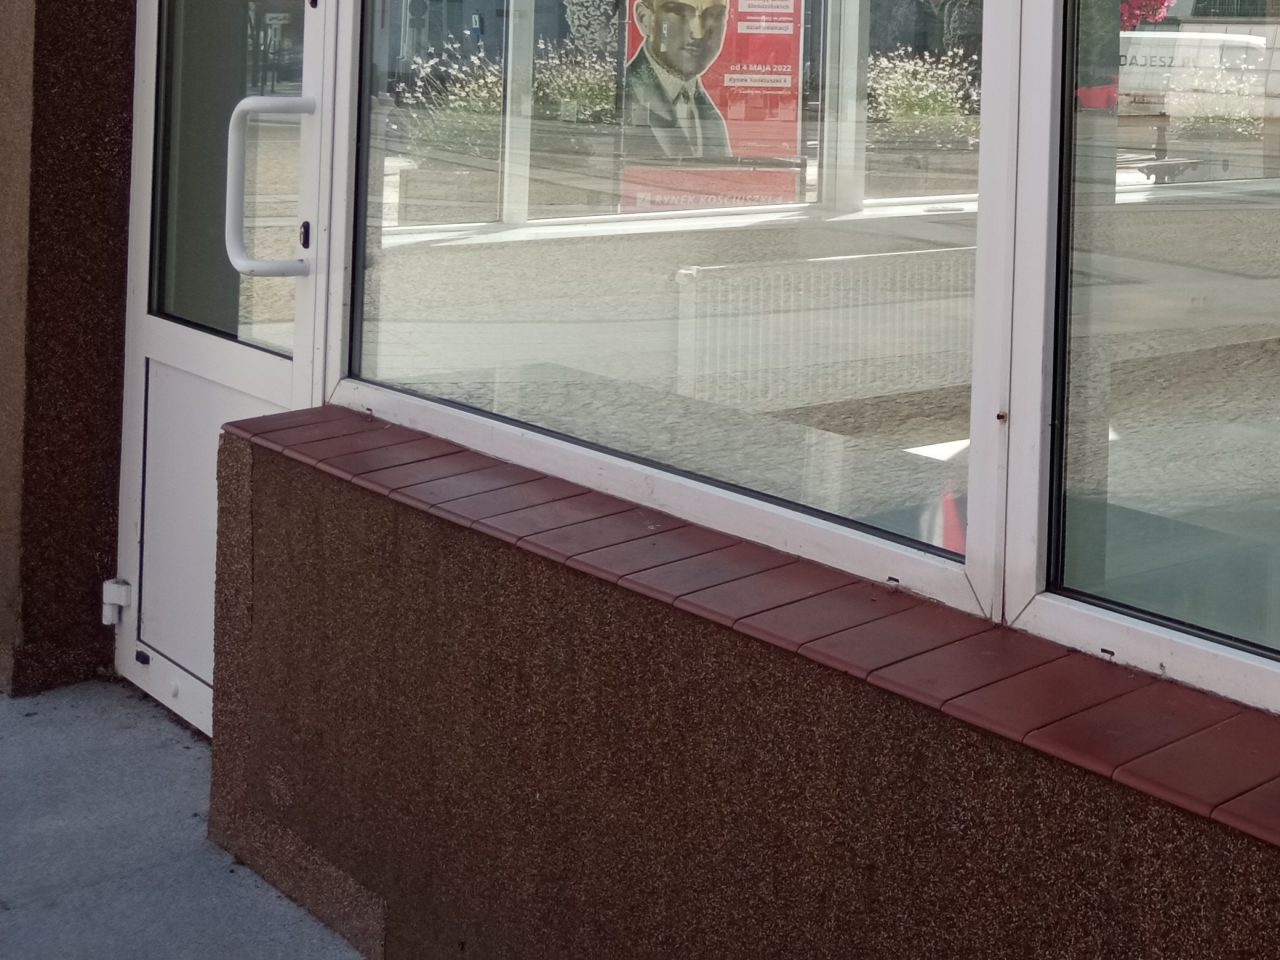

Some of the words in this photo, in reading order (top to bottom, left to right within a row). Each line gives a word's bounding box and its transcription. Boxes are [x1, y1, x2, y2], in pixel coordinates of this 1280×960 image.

[730, 63, 741, 71] od
[749, 63, 772, 73] MAJA
[772, 64, 792, 72] 2022
